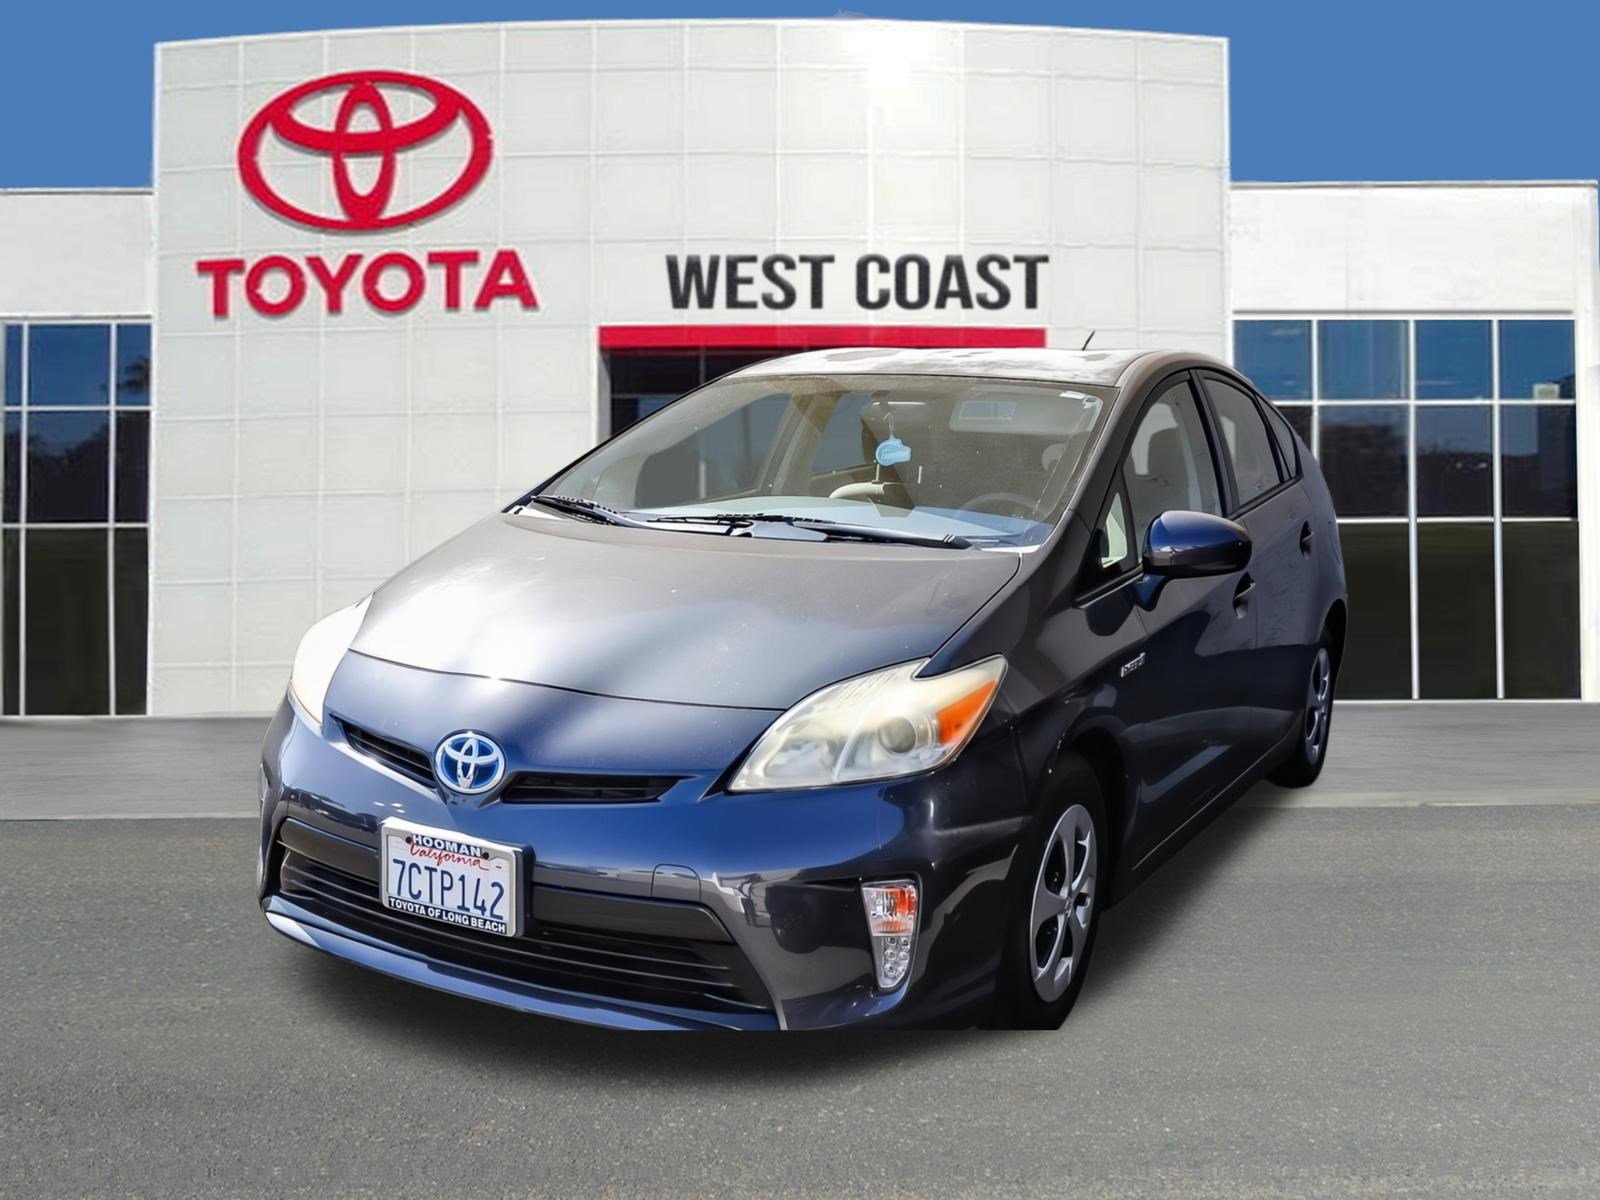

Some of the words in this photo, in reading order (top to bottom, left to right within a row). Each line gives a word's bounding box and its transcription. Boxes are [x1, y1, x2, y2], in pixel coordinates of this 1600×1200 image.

[196, 249, 540, 317] TOYOTA
[666, 254, 835, 310] WEST
[856, 254, 1050, 310] COAST
[412, 834, 482, 858] HOOMAN
[389, 897, 426, 915] TOYOTA
[427, 908, 442, 919] OF
[442, 910, 470, 926] LONG
[470, 917, 507, 933] BEACH
[393, 858, 505, 921] 7CTP142
